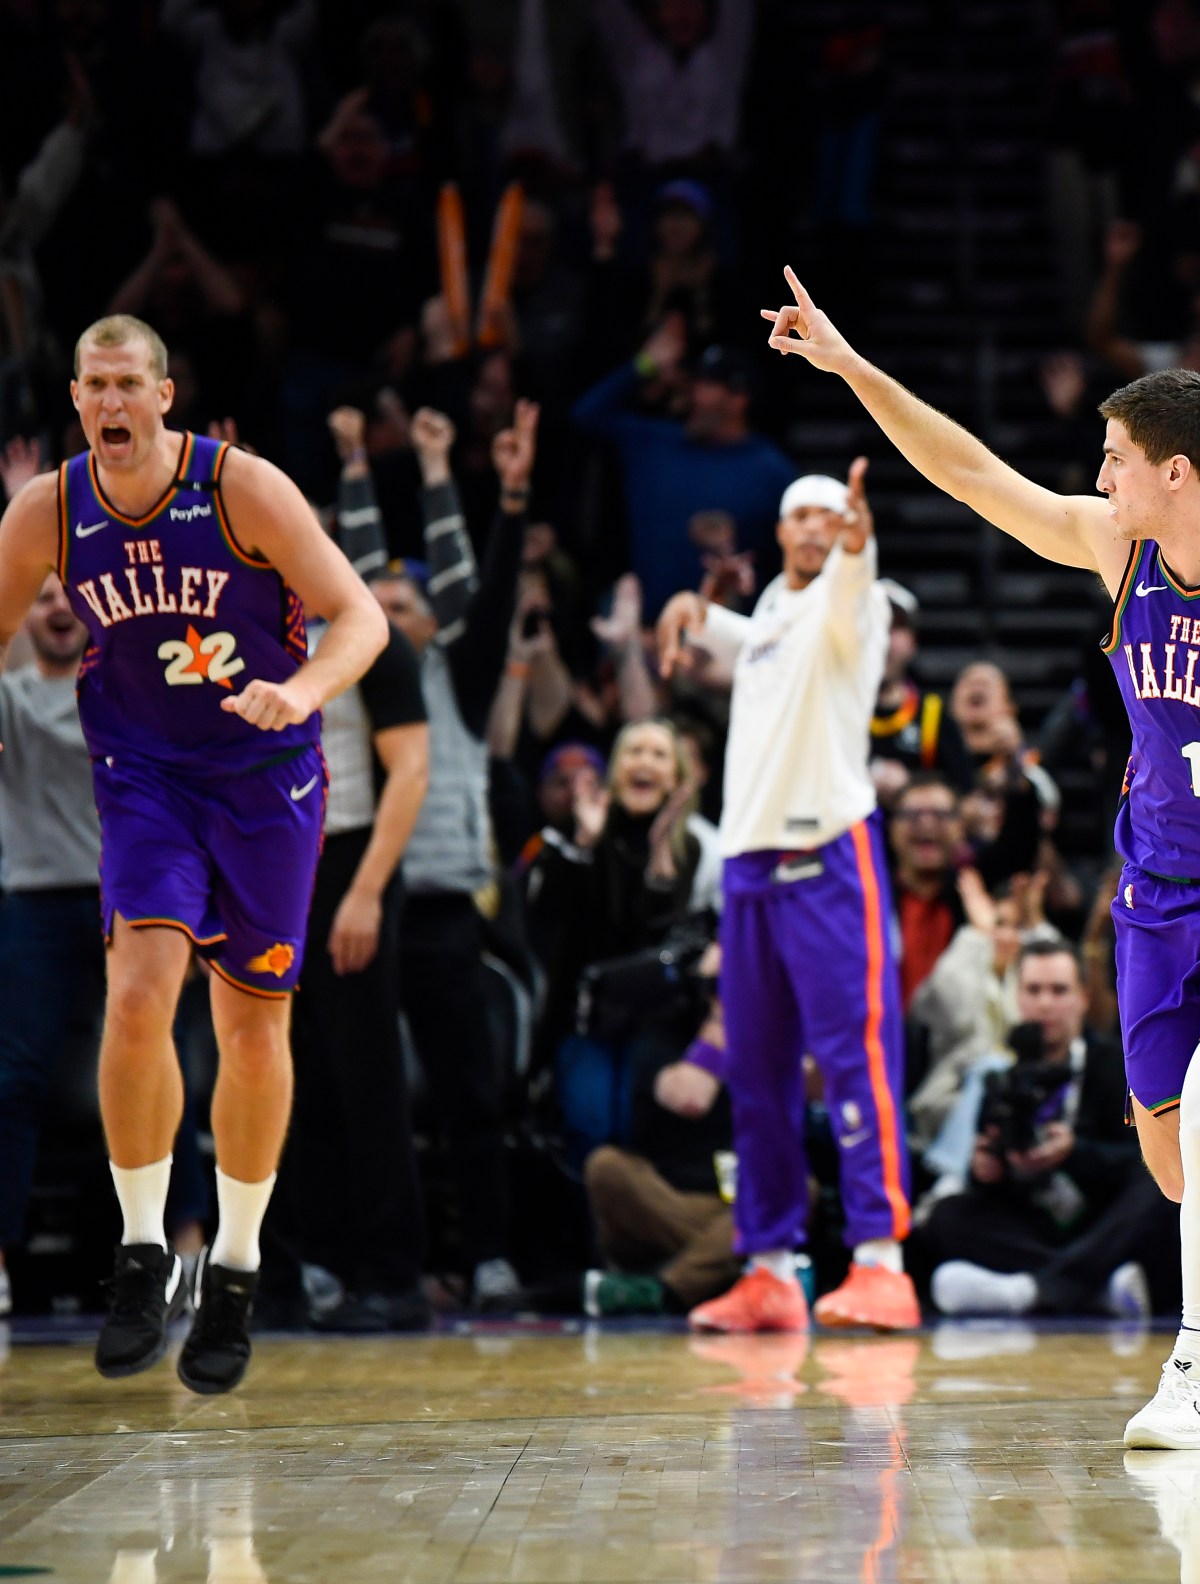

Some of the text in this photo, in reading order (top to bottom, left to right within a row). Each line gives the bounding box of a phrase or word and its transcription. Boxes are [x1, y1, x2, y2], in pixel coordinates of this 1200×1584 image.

[170, 503, 211, 522] PayPal
[124, 539, 162, 564] THE
[76, 565, 229, 628] VALLEY
[157, 631, 245, 686] 22
